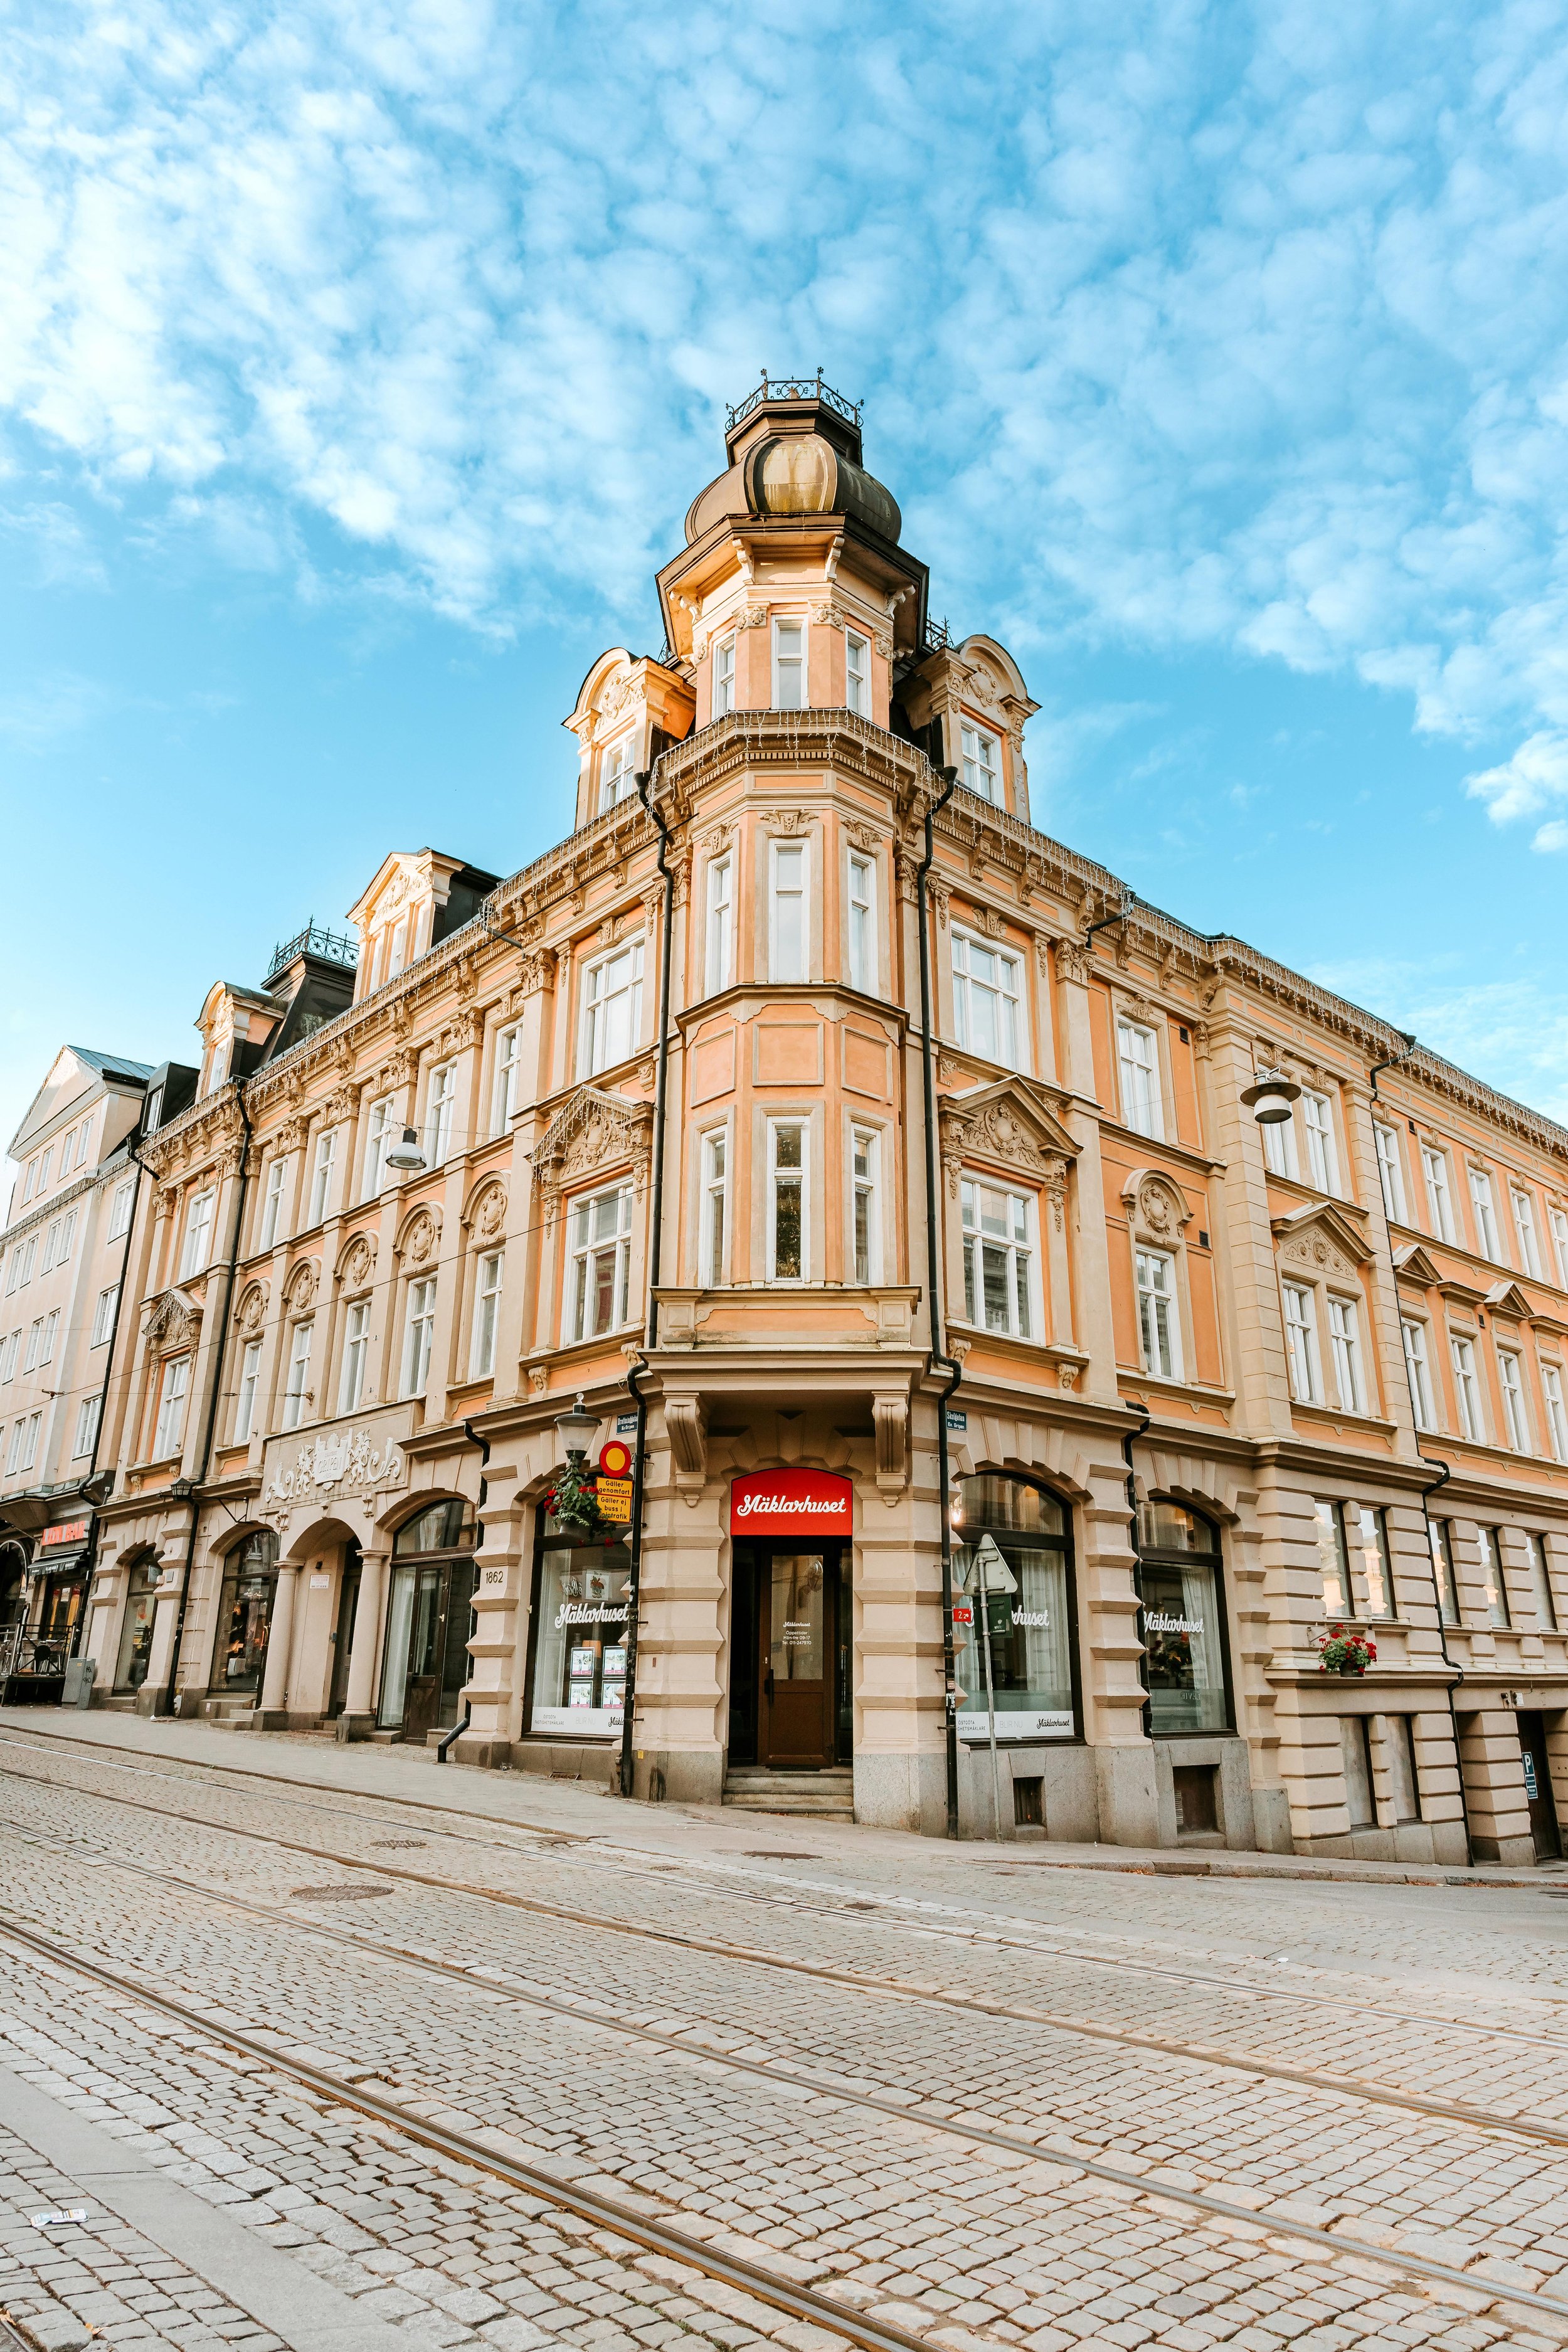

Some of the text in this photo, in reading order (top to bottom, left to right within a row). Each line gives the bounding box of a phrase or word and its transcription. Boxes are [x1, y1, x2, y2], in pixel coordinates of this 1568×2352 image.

[618, 1415, 638, 1426] Drottninggata
[947, 1411, 965, 1421] Skolgatan
[737, 1495, 847, 1517] Mäklarhuset
[65, 1520, 86, 1542] BAR
[486, 1571, 504, 1584] 1862
[554, 1601, 630, 1629] Mäklarhuset
[1143, 1611, 1204, 1633] Mäklarhuset
[999, 1720, 1023, 1729] BLIR NU
[1036, 1718, 1070, 1729] Mäklarhuset
